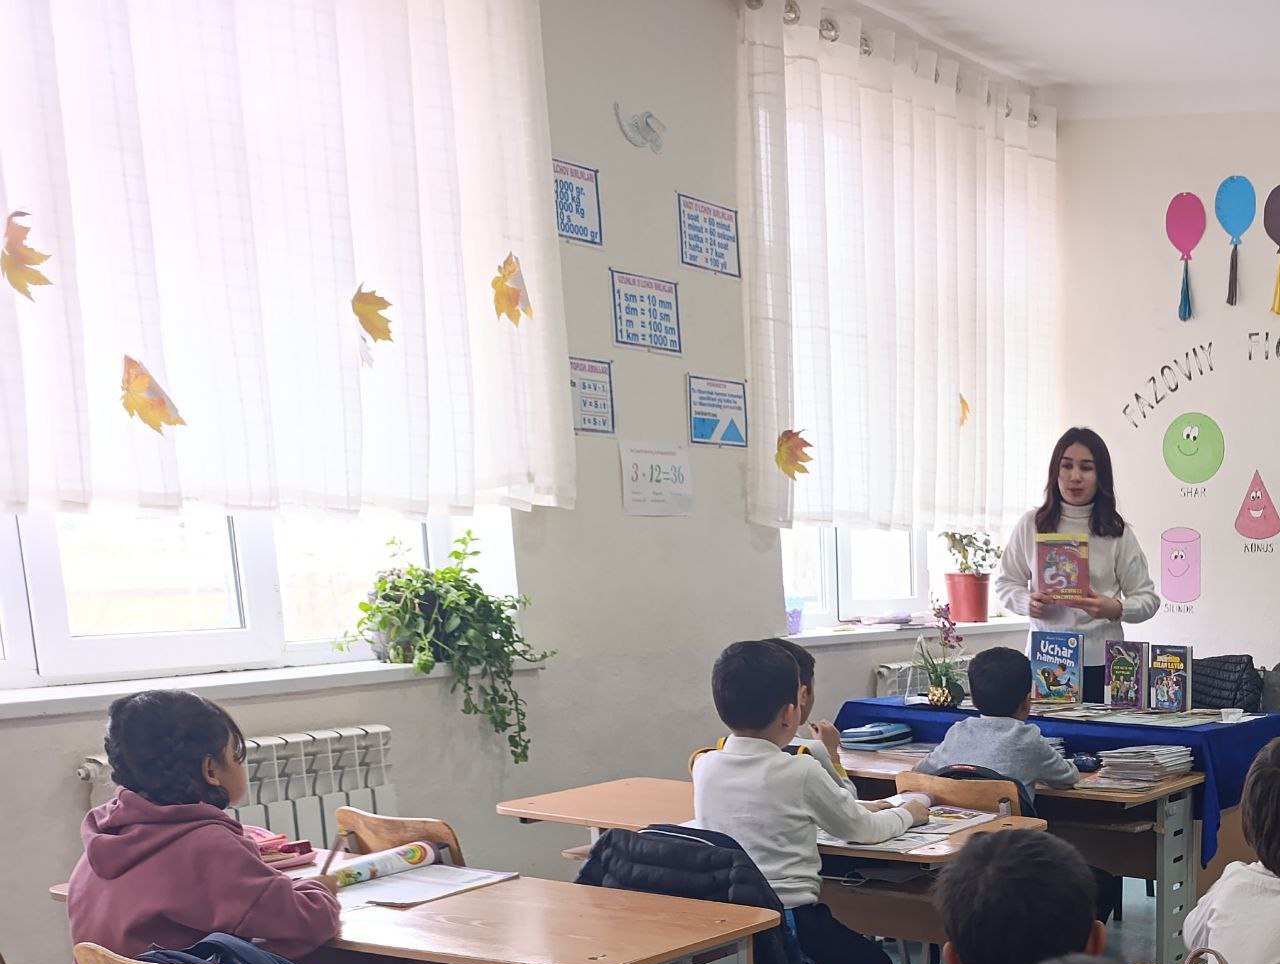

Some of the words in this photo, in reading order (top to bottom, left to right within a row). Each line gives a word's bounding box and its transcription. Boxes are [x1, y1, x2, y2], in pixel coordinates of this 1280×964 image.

[1122, 341, 1215, 429] FAZOVIY
[1180, 487, 1207, 498] SHAR
[1243, 542, 1275, 554] KONUS
[1041, 640, 1074, 659] Uchar
[1036, 652, 1076, 669] hammom
